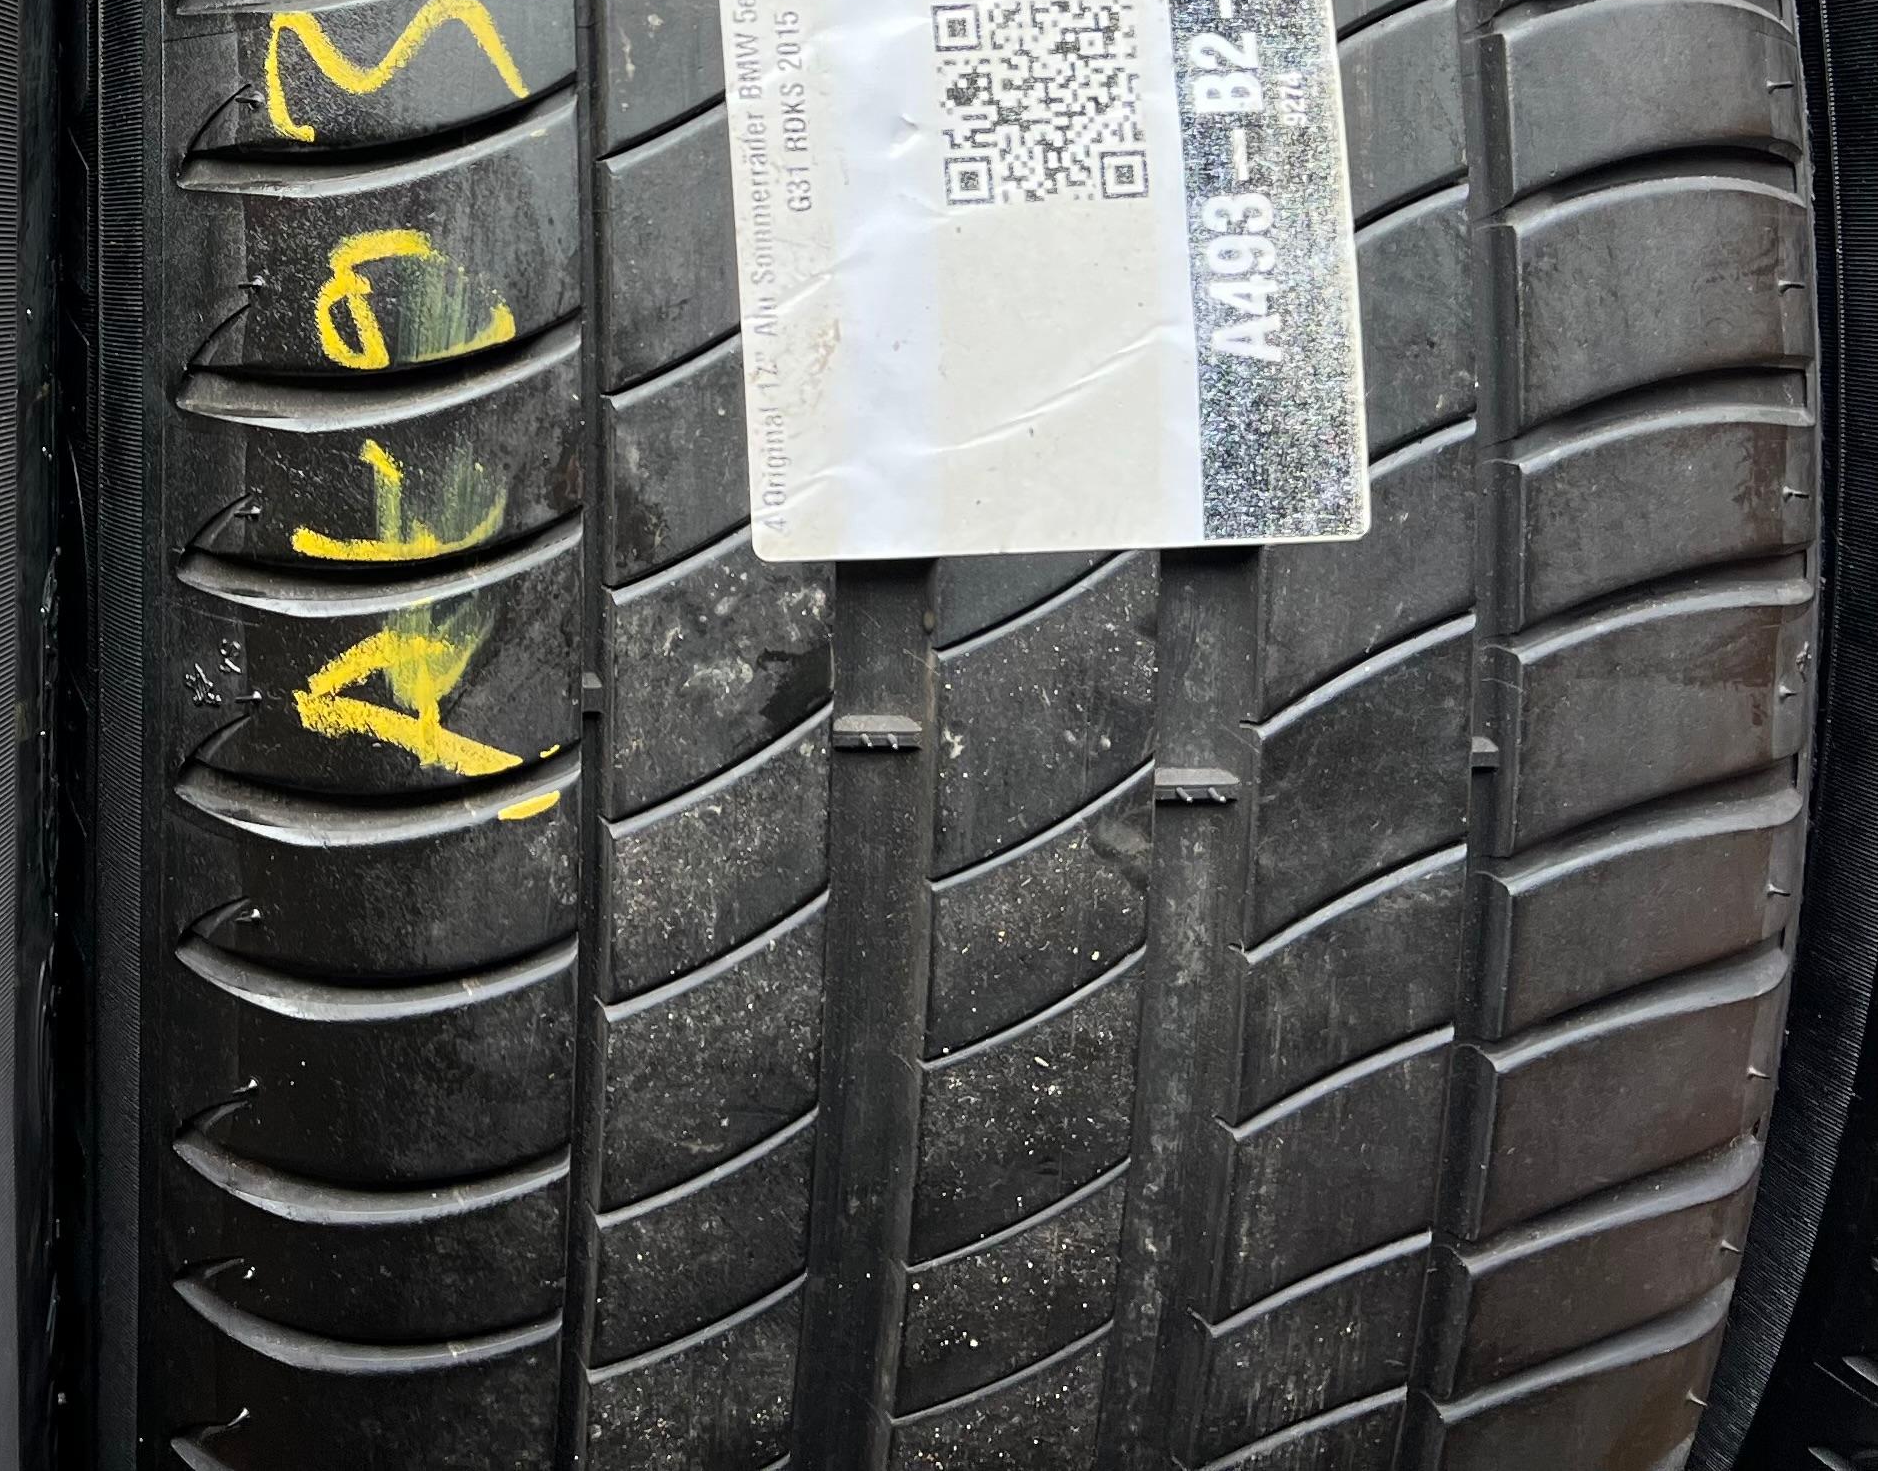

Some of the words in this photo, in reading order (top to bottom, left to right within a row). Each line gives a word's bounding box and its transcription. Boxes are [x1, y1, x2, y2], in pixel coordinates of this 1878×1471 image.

[738, 33, 763, 100] BMW
[774, 10, 803, 72] 2015
[779, 81, 809, 152] RDKS
[1278, 73, 1307, 128] 9274
[739, 111, 774, 286] Sommerräder
[787, 166, 812, 212] G31
[763, 409, 792, 507] Original
[764, 516, 786, 534] 4
